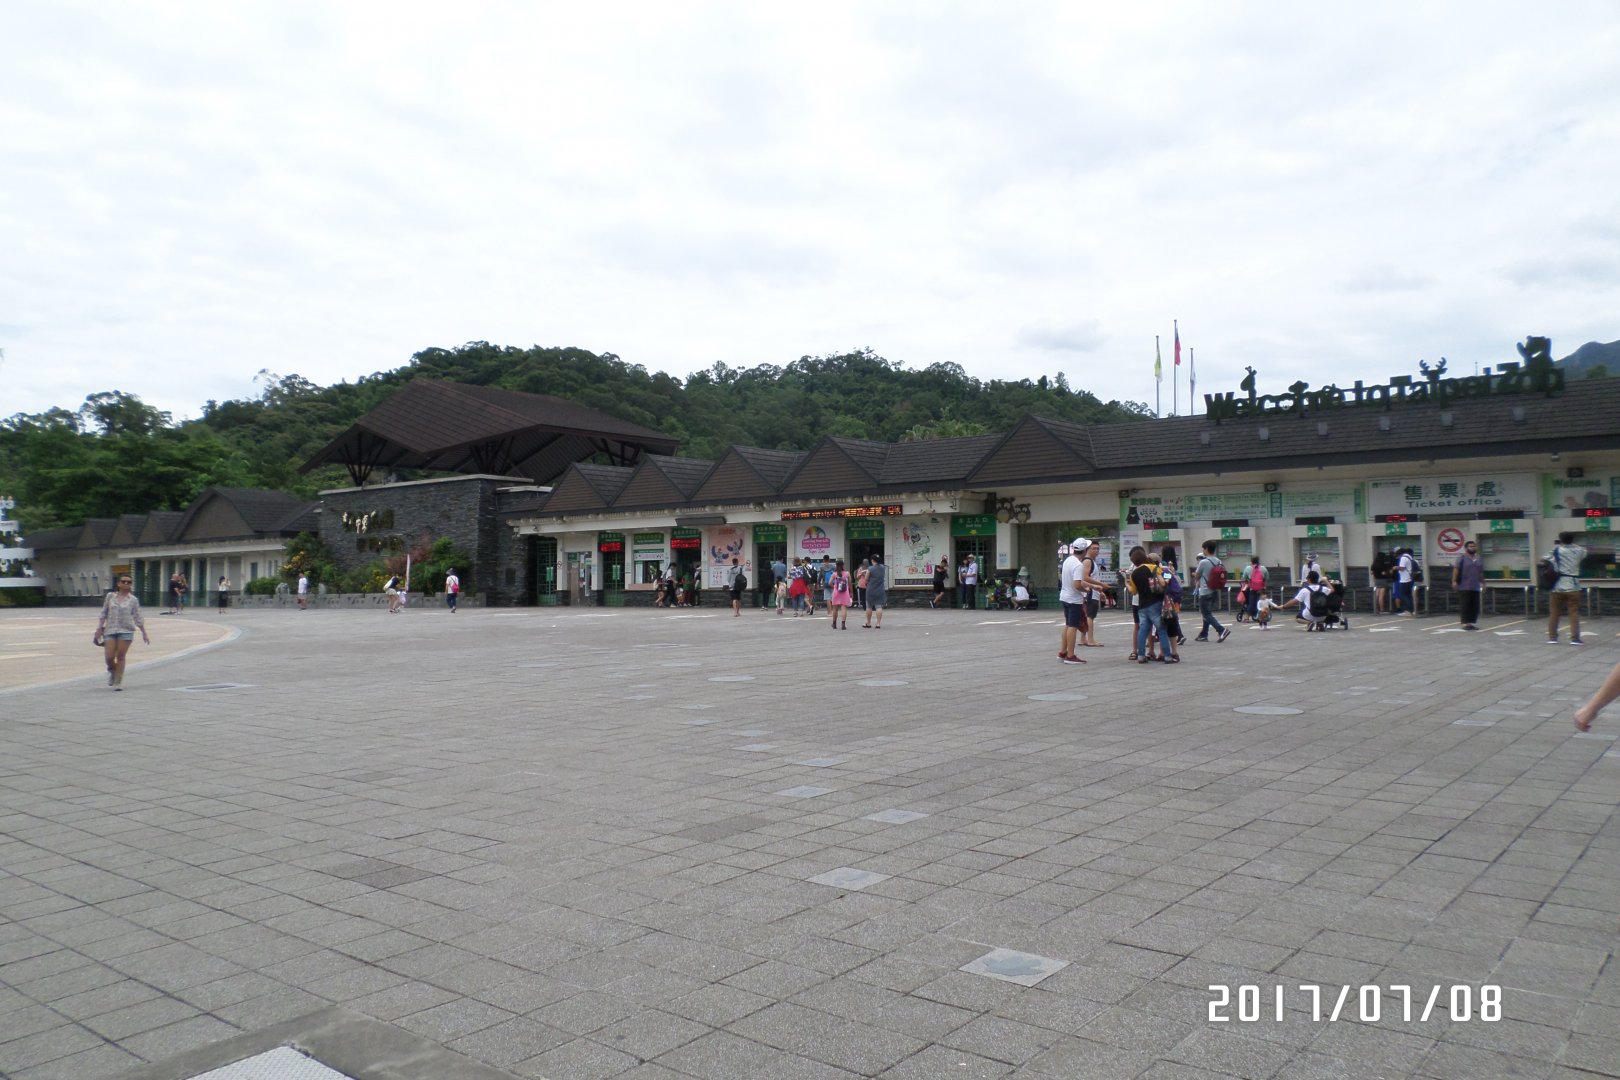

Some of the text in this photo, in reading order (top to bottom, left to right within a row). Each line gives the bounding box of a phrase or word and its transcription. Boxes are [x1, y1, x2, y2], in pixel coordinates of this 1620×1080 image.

[1204, 366, 1345, 420] Welcome
[1354, 380, 1389, 407] to
[1390, 358, 1491, 407] Taipei
[1553, 478, 1601, 488] Welcome
[1406, 498, 1503, 509] Ticket office
